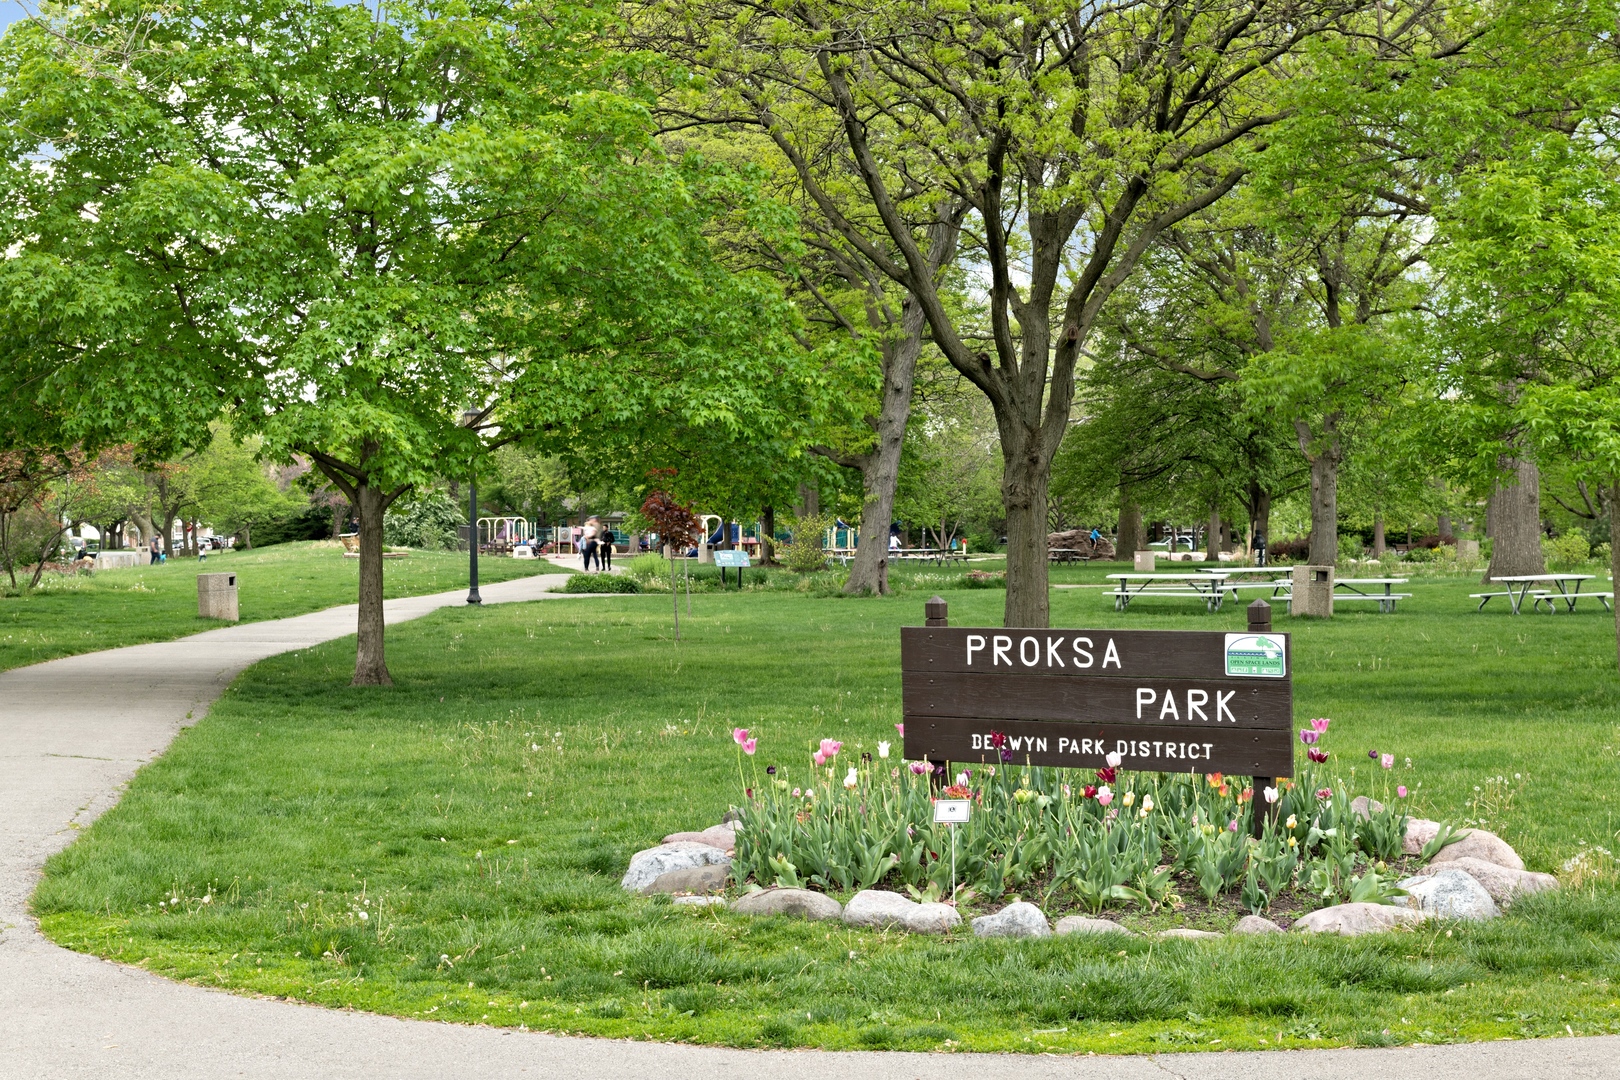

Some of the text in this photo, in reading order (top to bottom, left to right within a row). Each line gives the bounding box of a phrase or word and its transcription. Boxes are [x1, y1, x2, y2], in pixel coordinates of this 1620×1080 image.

[966, 634, 1122, 670] PROKSA
[1136, 687, 1237, 723] PARK
[971, 733, 1214, 760] BEWYN PARK DISTRICT
